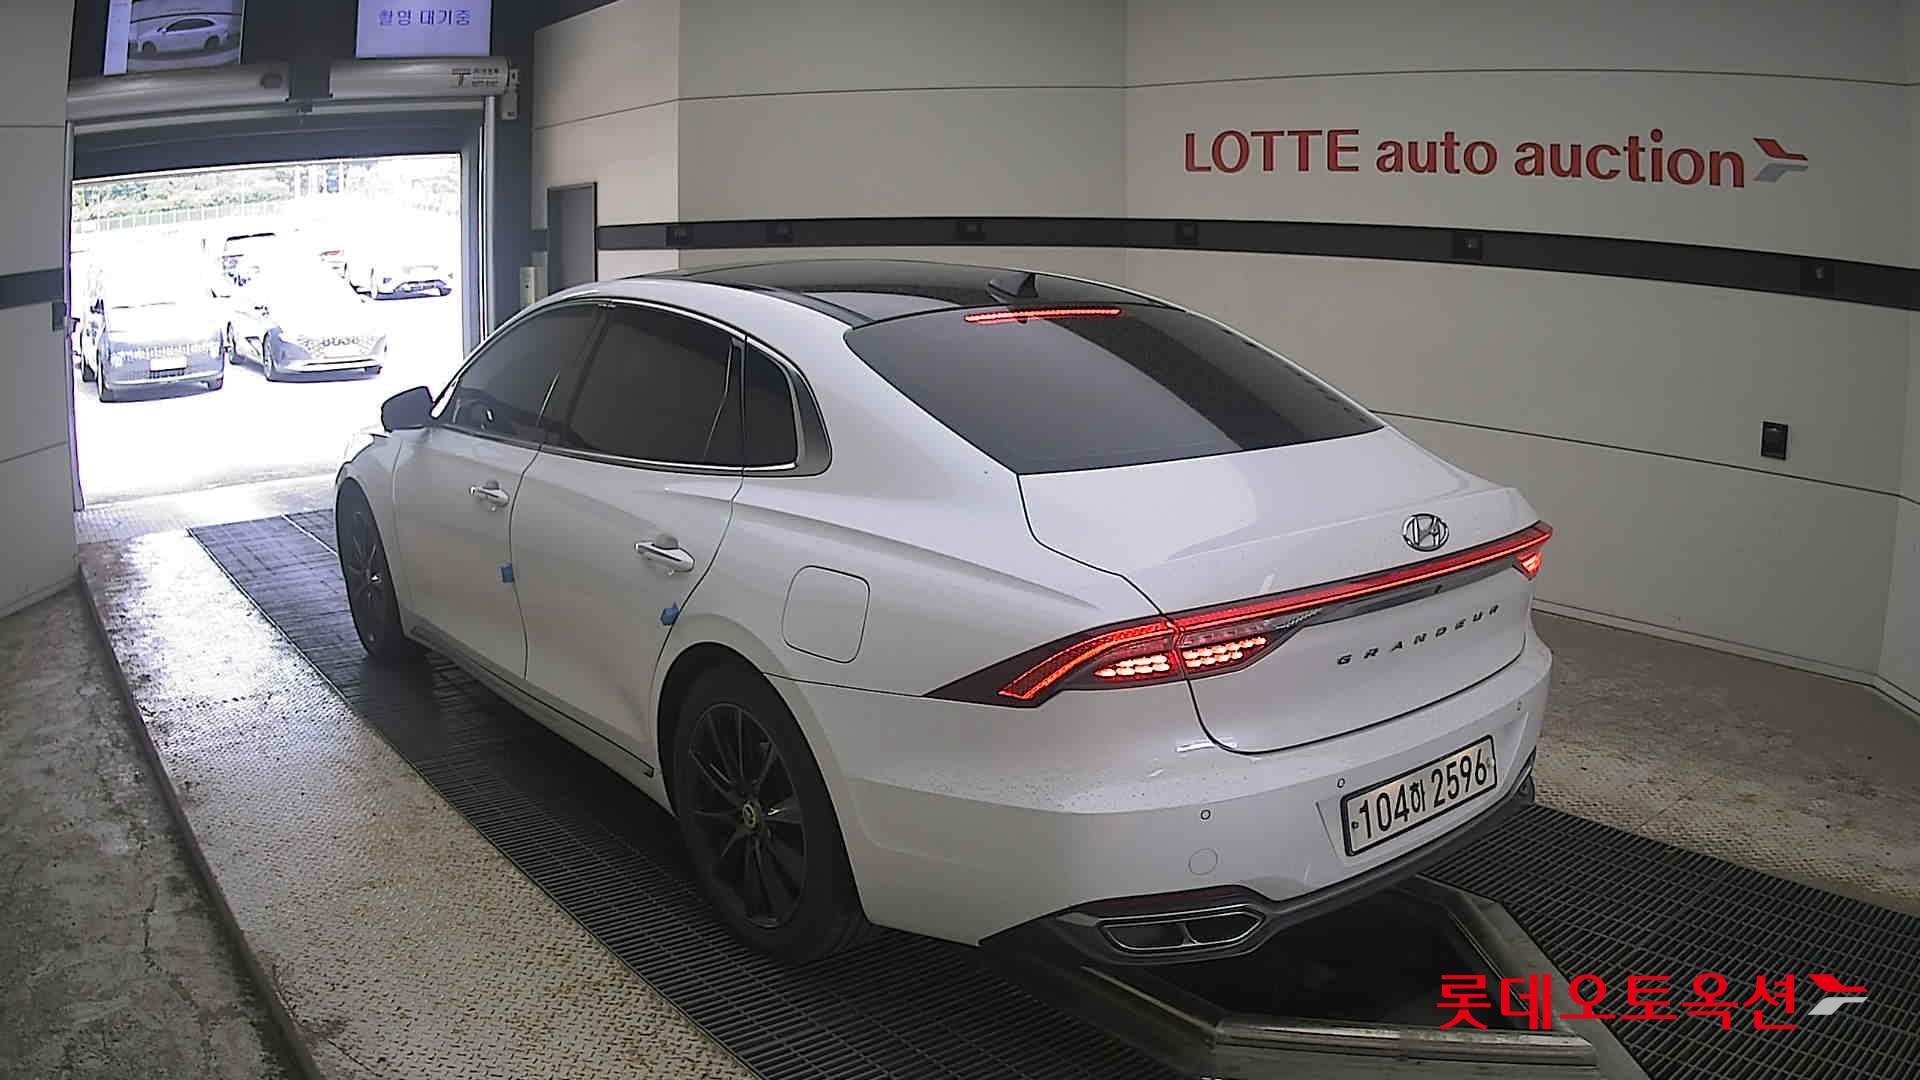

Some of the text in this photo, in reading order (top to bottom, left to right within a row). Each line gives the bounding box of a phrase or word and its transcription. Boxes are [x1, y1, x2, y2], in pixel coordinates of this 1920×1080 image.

[420, 9, 471, 26] 대기중
[1184, 128, 1745, 188] LOTTE auto auction
[1337, 604, 1499, 665] GRANDEUR
[1359, 748, 1487, 839] 104하 2596
